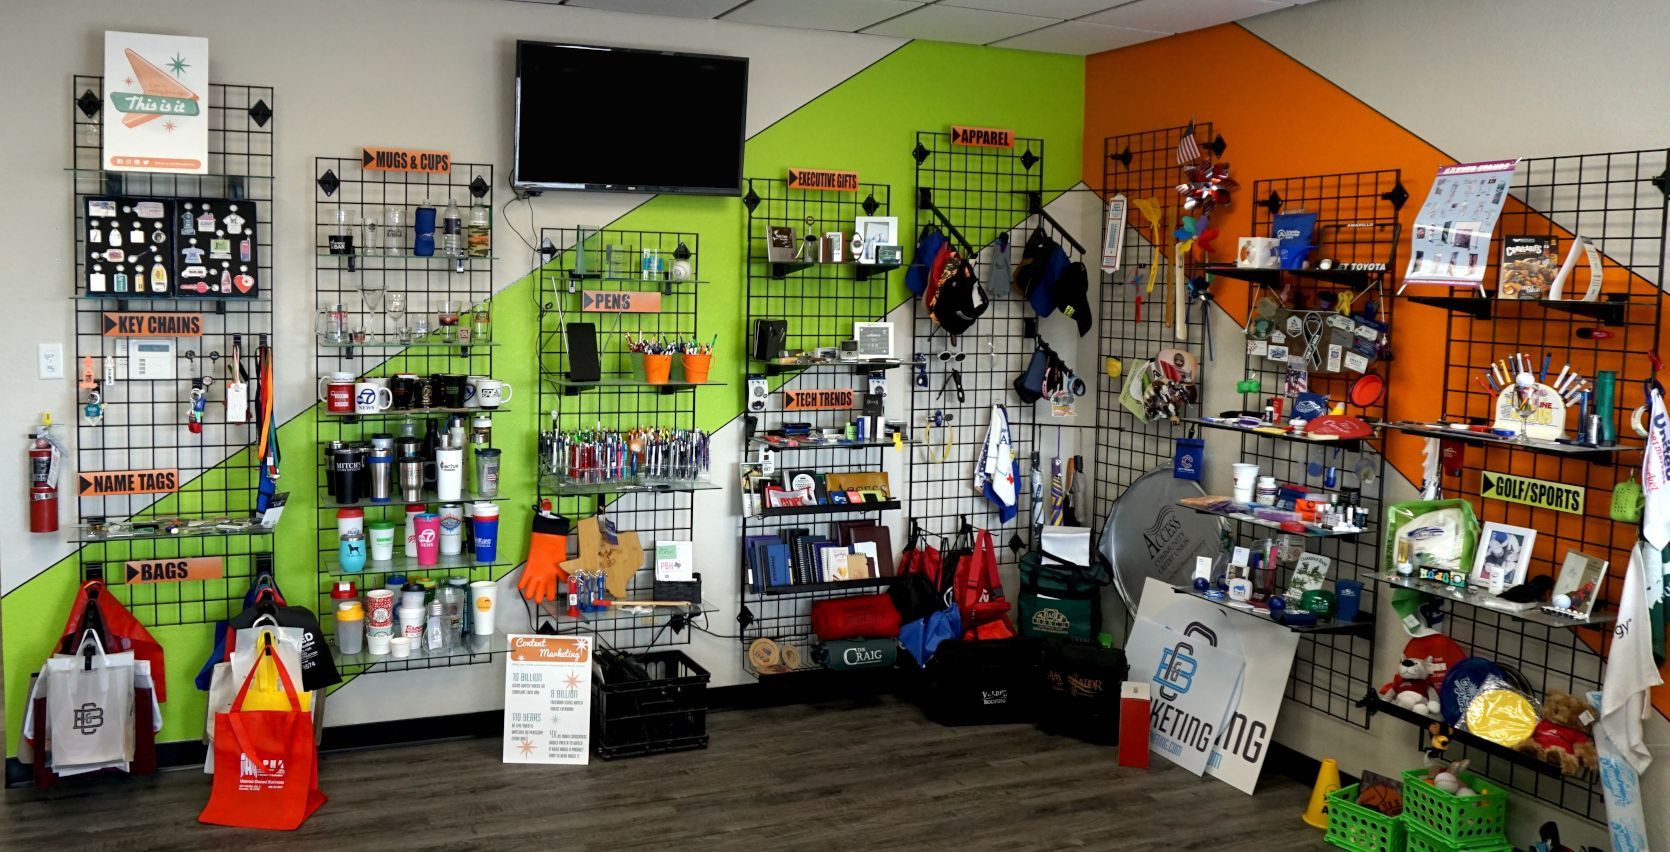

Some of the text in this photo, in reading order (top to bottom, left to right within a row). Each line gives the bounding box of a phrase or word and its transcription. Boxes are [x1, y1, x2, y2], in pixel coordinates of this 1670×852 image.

[125, 95, 186, 112] This is it
[961, 129, 1009, 147] APPAREL
[375, 150, 448, 171] MUGS & CUPS
[798, 173, 857, 189] EXECUTIVE GIFTS
[1351, 263, 1385, 271] TOYOTA
[595, 294, 631, 310] PENS
[118, 316, 200, 334] KEY CHAINS
[795, 393, 817, 407] TECH
[819, 392, 852, 406] TRENDS
[93, 472, 175, 492] NAME TAGS
[1495, 475, 1581, 513] GOLF/SPORTS
[1143, 514, 1181, 561] ACCESS
[140, 561, 188, 580] BAGS
[516, 637, 547, 648] Content
[539, 648, 581, 662] Marketing
[843, 647, 882, 665] CRAIG
[521, 672, 543, 682] BILLION
[556, 690, 578, 698] BILLION
[523, 713, 542, 722] YEARS
